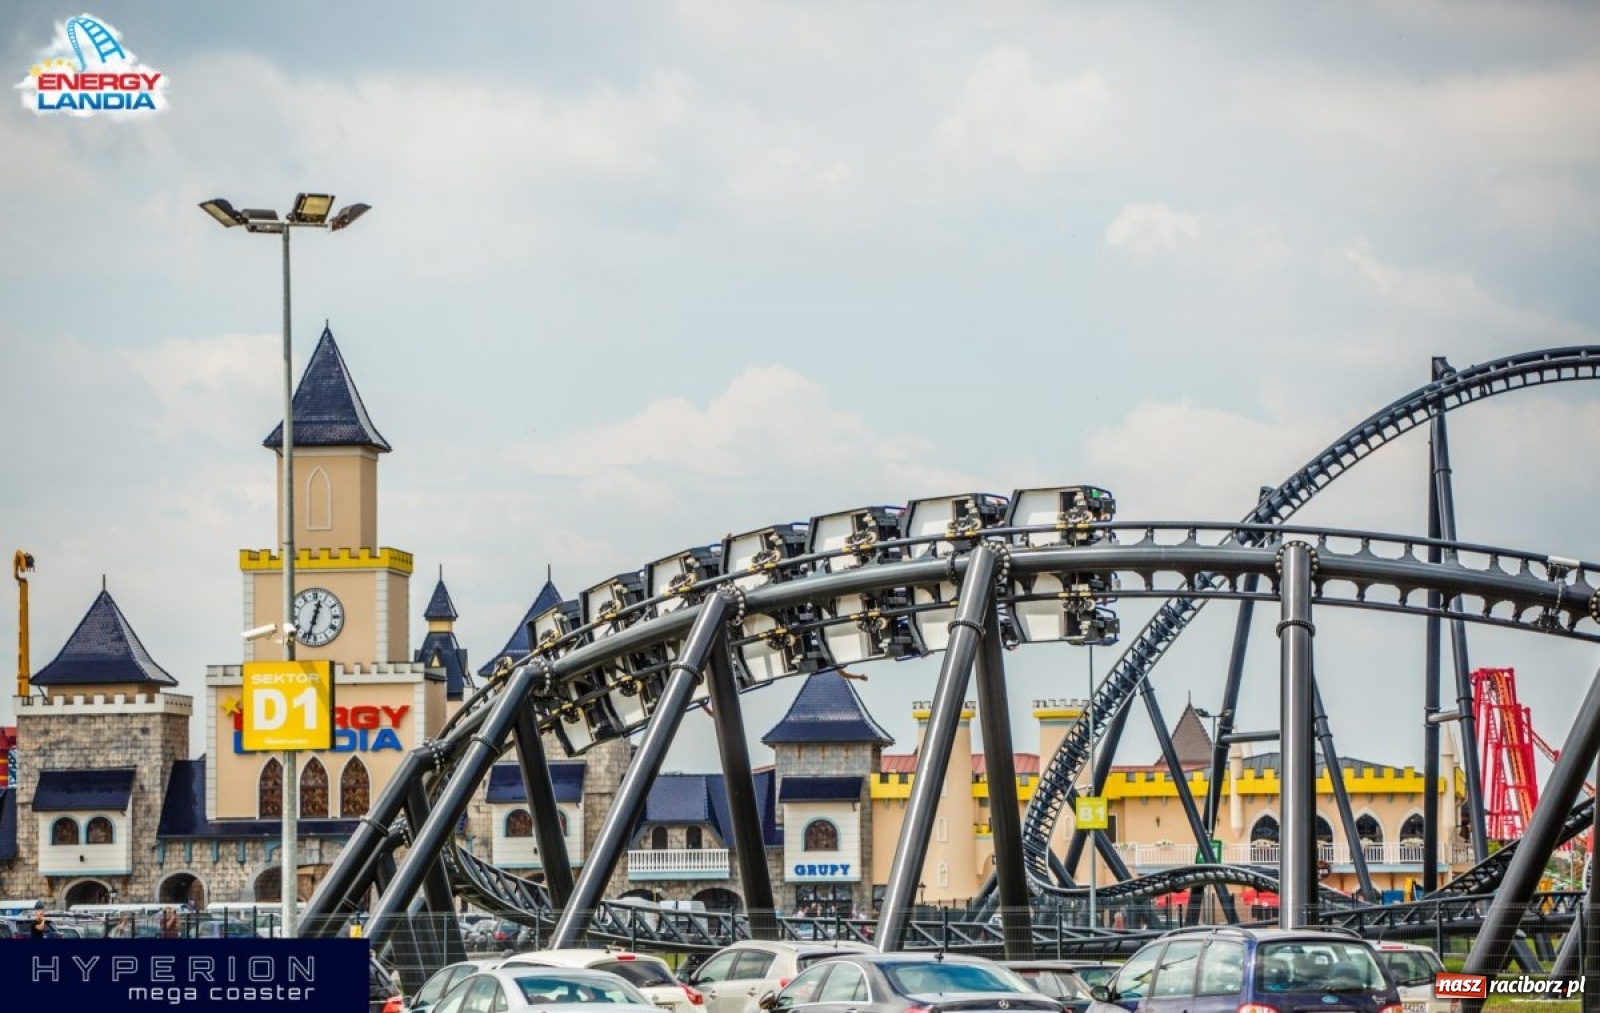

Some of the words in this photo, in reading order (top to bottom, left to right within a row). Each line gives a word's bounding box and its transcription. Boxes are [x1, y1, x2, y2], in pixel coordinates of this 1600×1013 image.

[251, 673, 320, 685] SEKTOR
[252, 687, 318, 731] D1
[234, 706, 410, 729] RGY
[1079, 806, 1104, 822] B1
[794, 864, 851, 876] GRUPY
